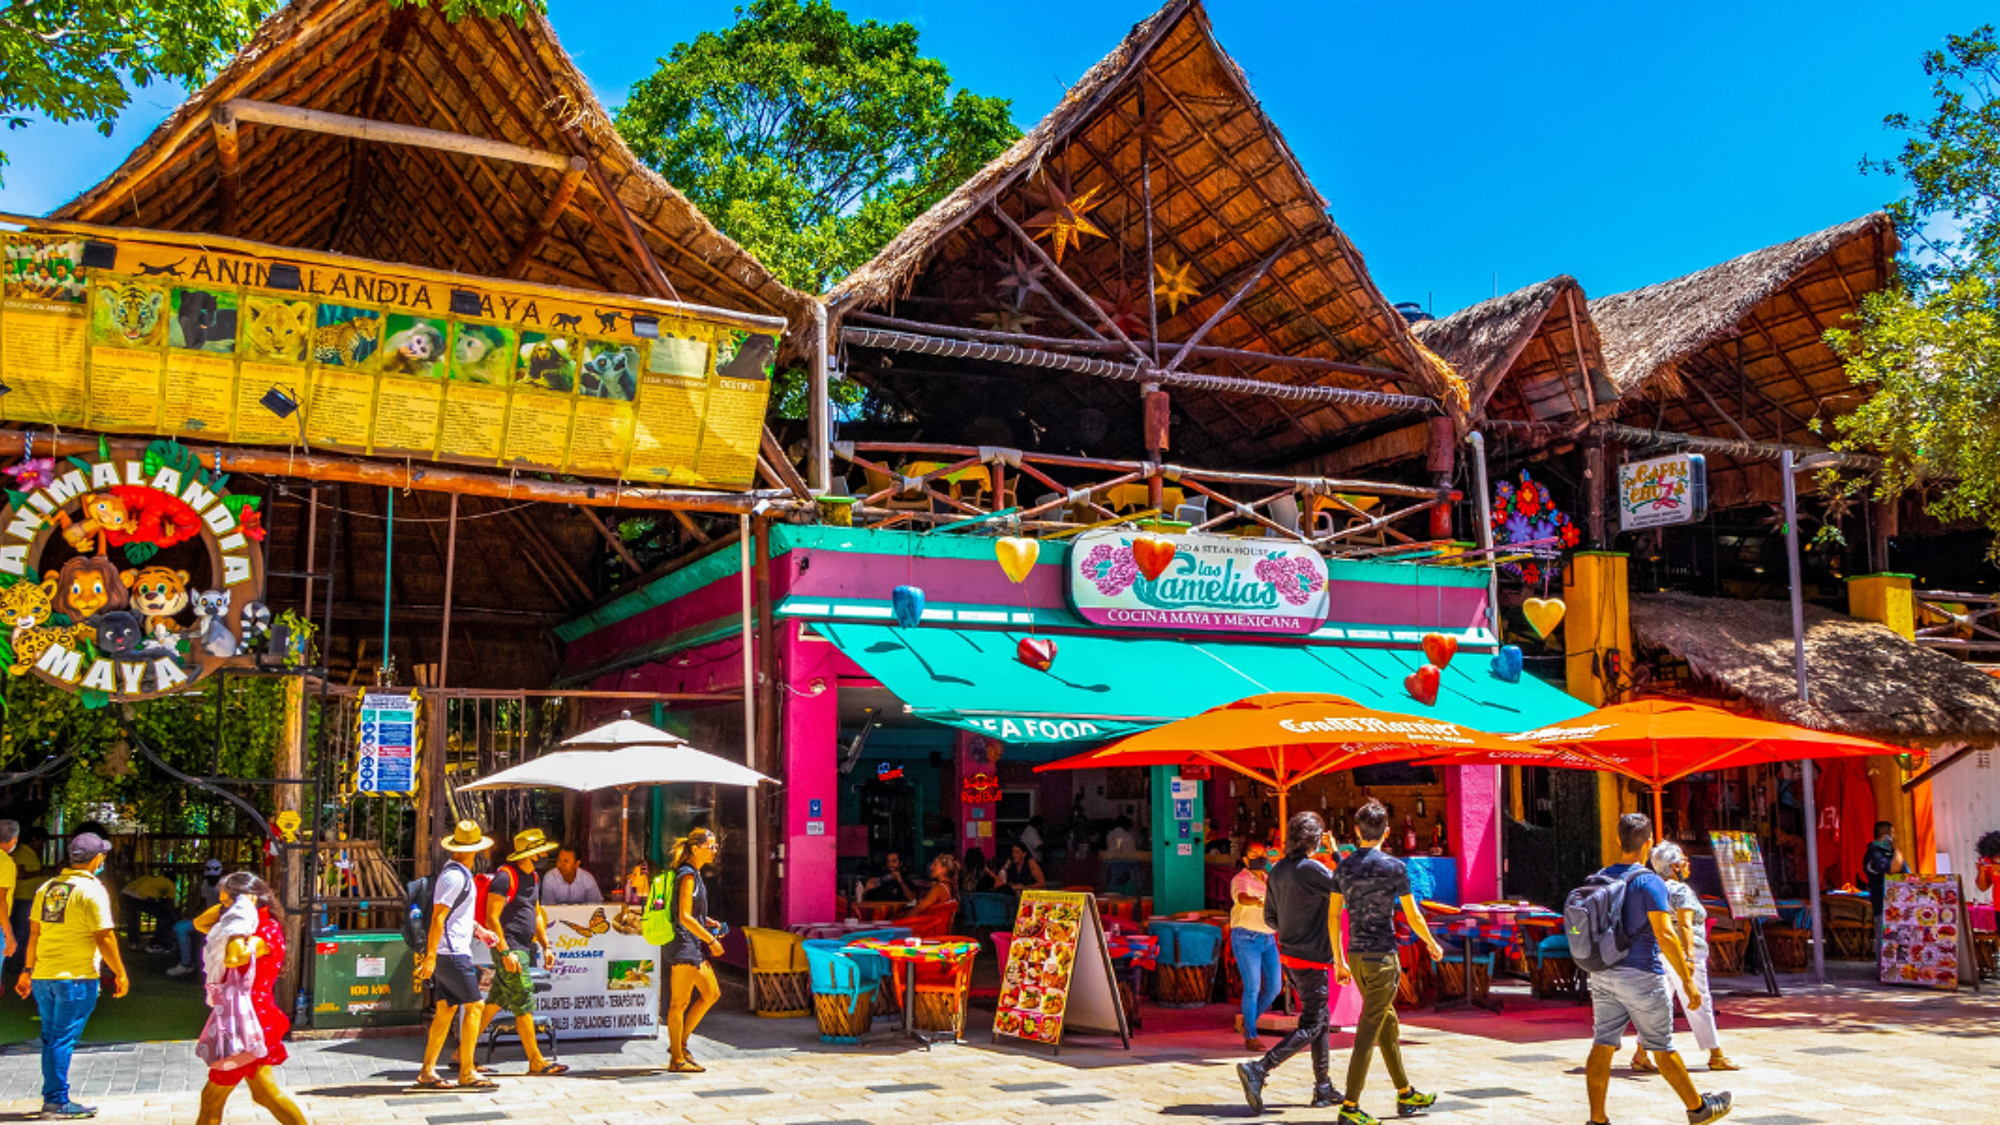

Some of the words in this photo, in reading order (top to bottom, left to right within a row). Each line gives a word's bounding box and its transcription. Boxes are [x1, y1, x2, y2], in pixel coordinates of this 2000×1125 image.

[449, 290, 541, 325] AYA
[0, 460, 251, 587] ANIMALANDIA
[1202, 545, 1233, 554] STEAK
[1199, 560, 1222, 577] las
[1108, 609, 1168, 623] COCINA
[1170, 612, 1210, 625] MAYA
[1213, 614, 1223, 625] Y
[1225, 614, 1300, 628] MEXICANA
[35, 643, 189, 695] MAYA
[968, 718, 1022, 738] EA
[961, 791, 982, 803] Red
[983, 790, 1002, 803] Bull
[555, 934, 590, 951] Spa
[558, 950, 604, 959] MASSAGE
[349, 985, 369, 996] 100
